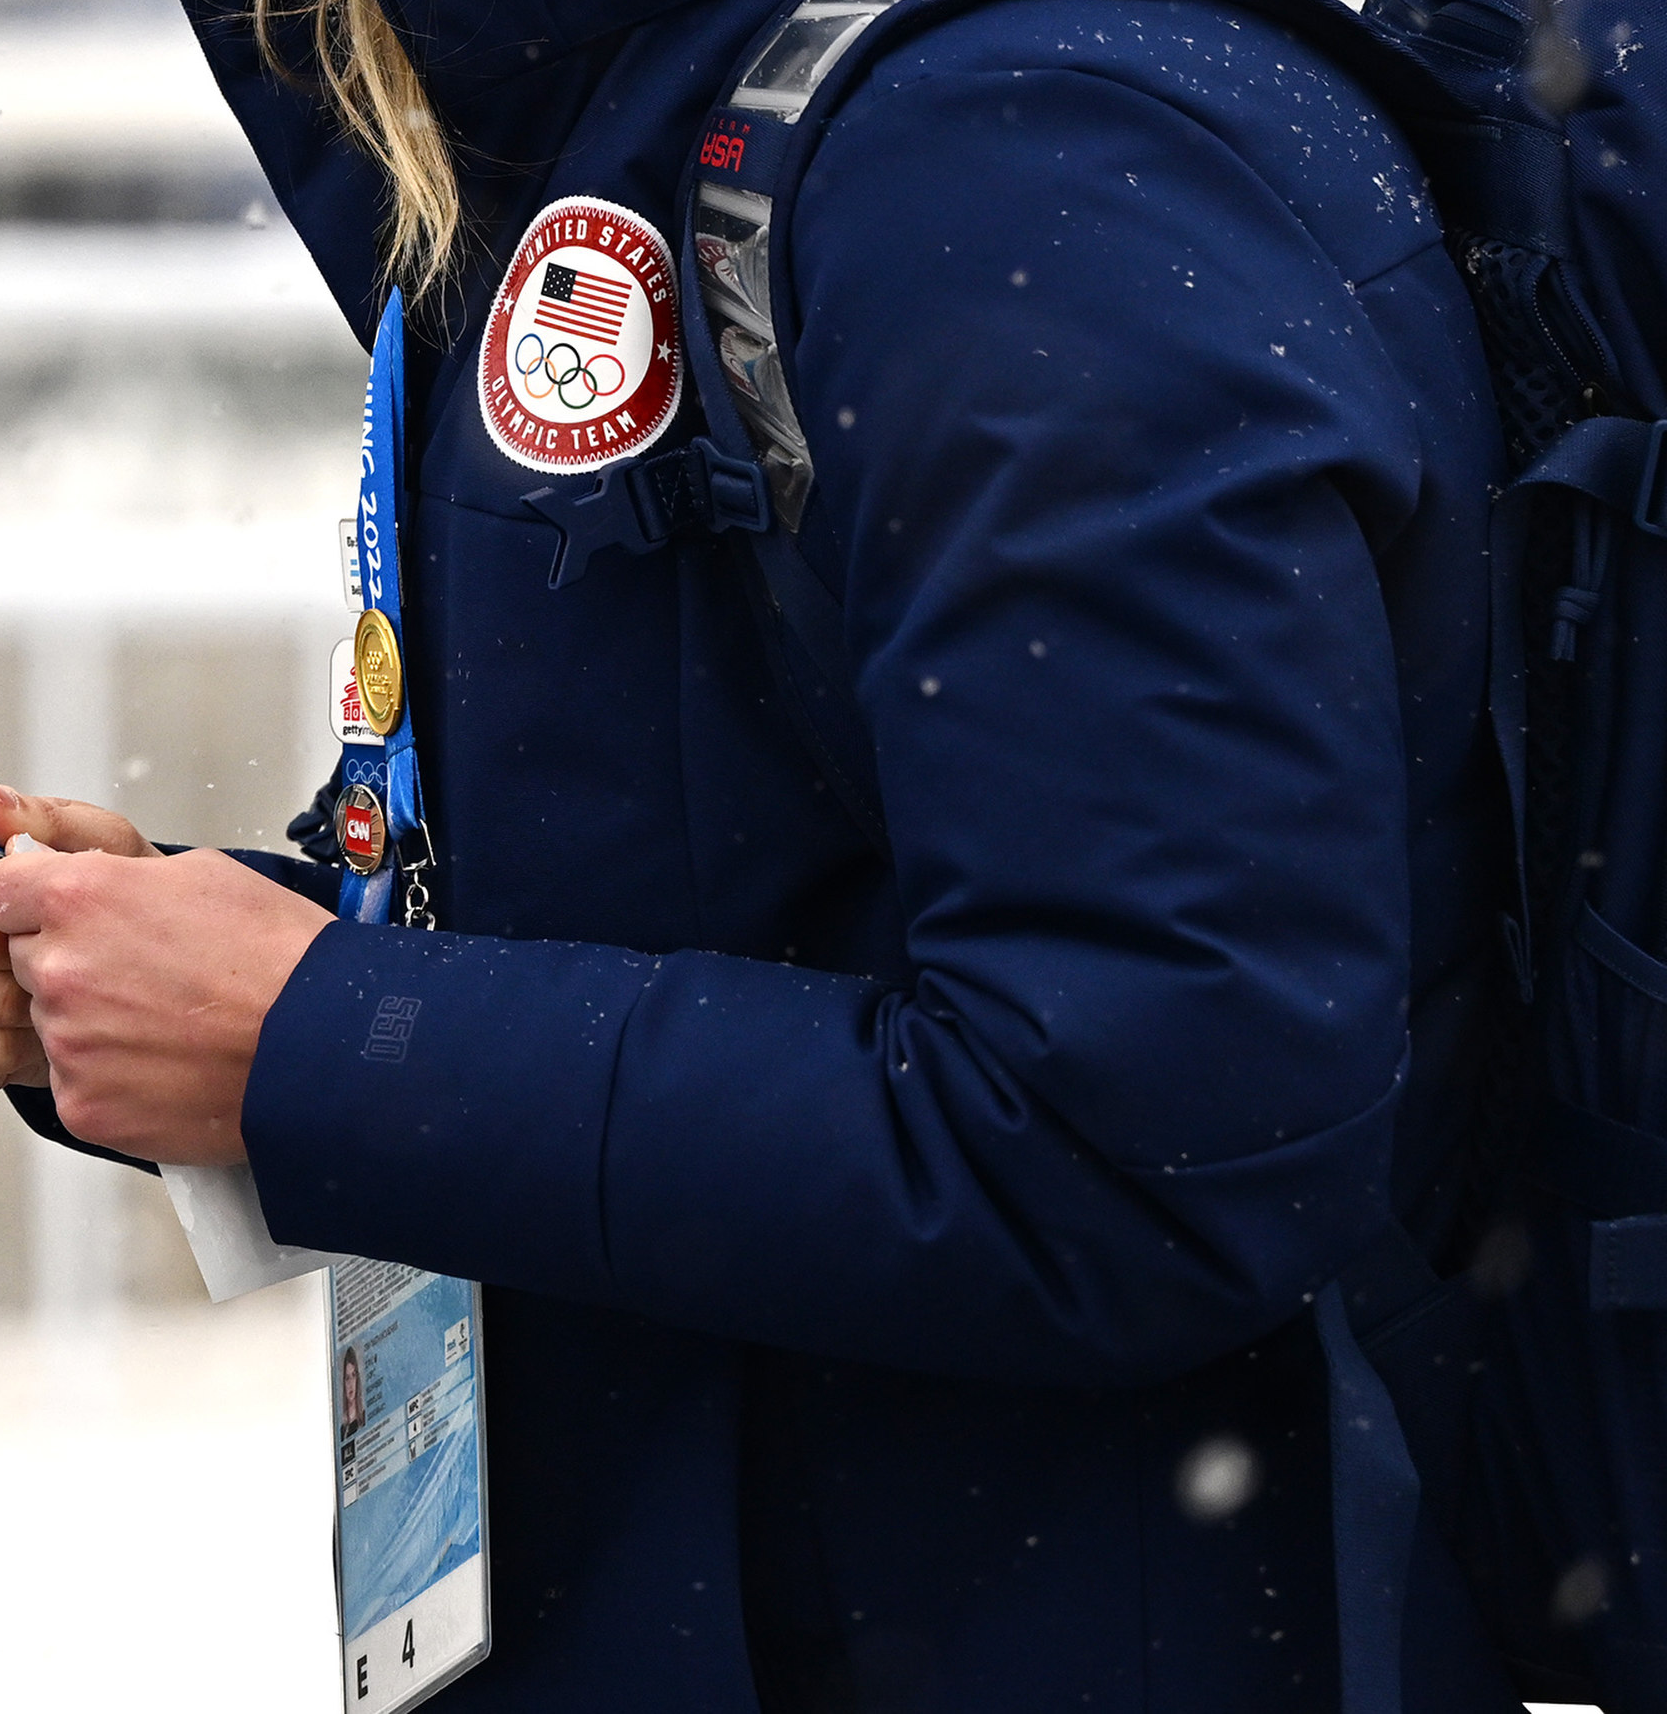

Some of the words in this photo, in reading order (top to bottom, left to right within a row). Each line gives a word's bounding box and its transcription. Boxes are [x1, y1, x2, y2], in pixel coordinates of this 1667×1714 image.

[700, 132, 745, 173] USA
[525, 219, 588, 266] UNITED
[598, 225, 667, 303] STATES
[492, 375, 558, 450] OLYMPIC
[570, 409, 637, 450] TEAM
[361, 492, 383, 609] 2022
[347, 819, 370, 842] CNN
[402, 1618, 415, 1669] 4
[357, 1654, 369, 1700] E
